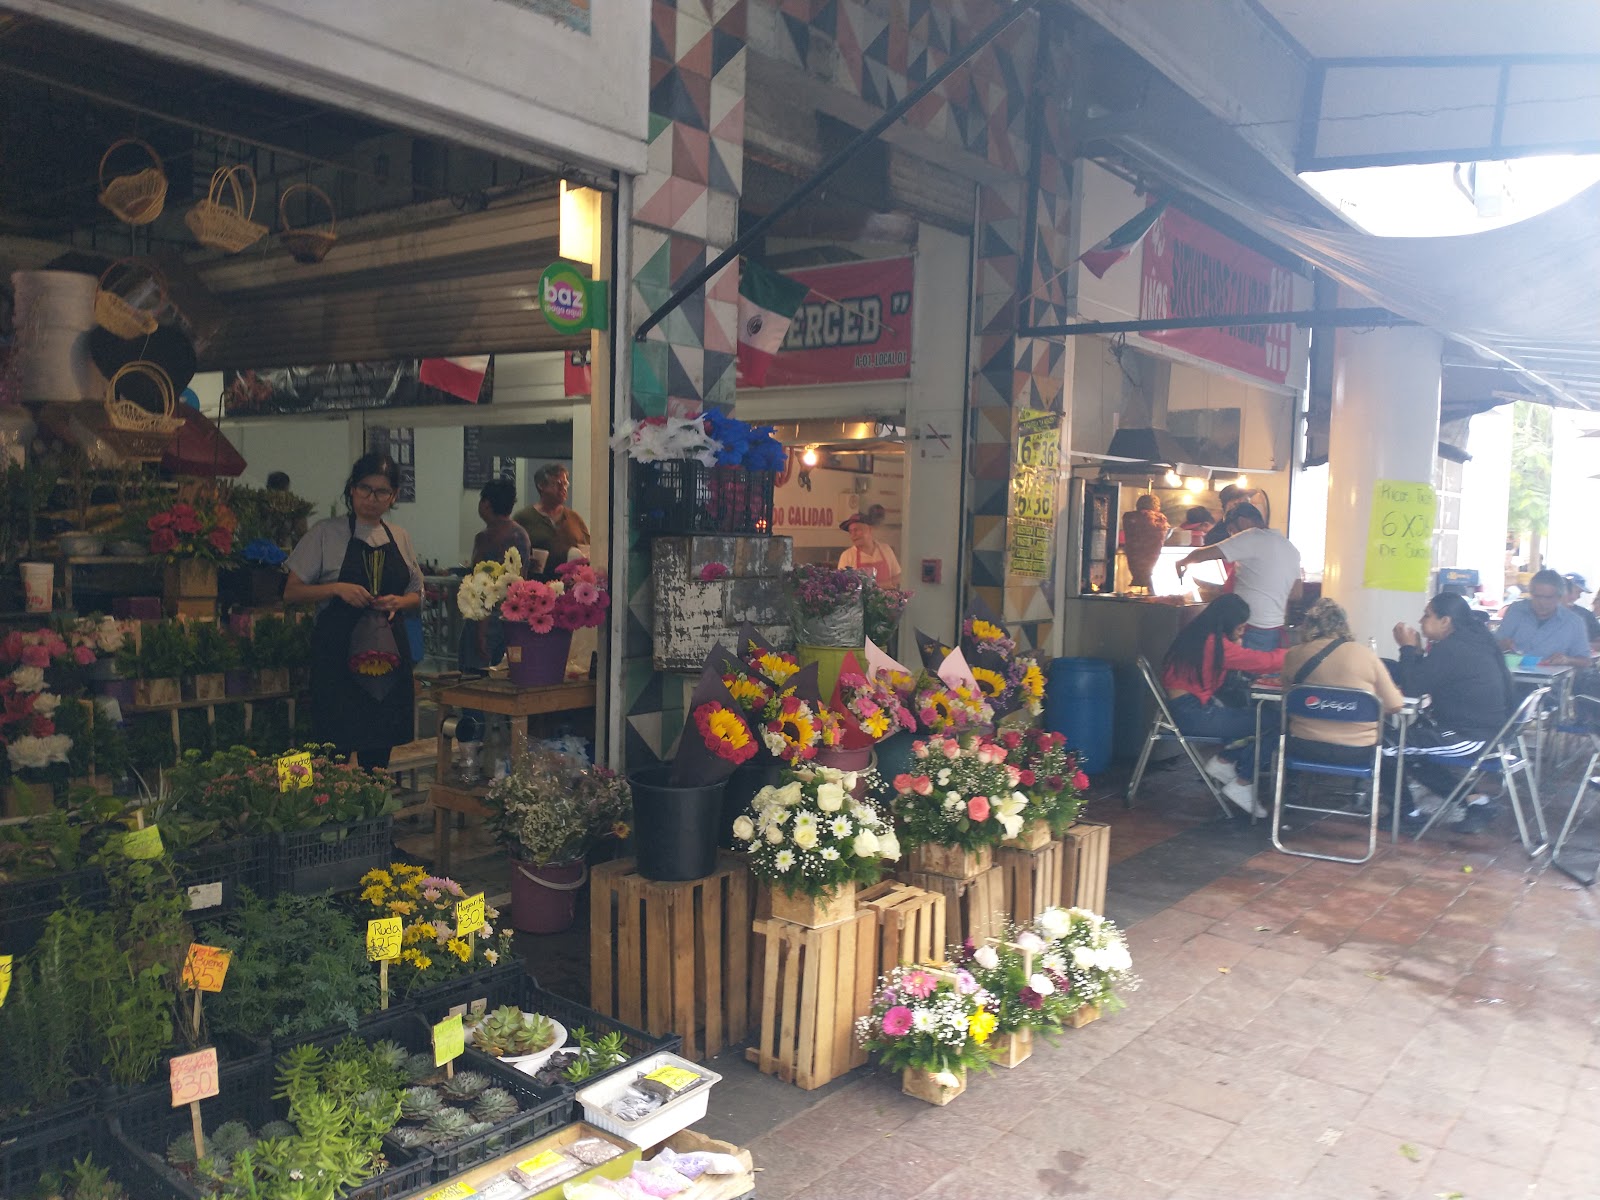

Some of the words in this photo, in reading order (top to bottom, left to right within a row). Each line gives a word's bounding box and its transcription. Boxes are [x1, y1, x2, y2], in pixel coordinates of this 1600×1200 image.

[544, 276, 584, 308] baz
[1141, 265, 1168, 335] AÑOS
[783, 297, 881, 349] ERCED
[788, 507, 833, 527] CALIDAD
[1319, 700, 1358, 712] pepsi
[457, 897, 485, 914] Margarita
[371, 921, 401, 936] Ruda
